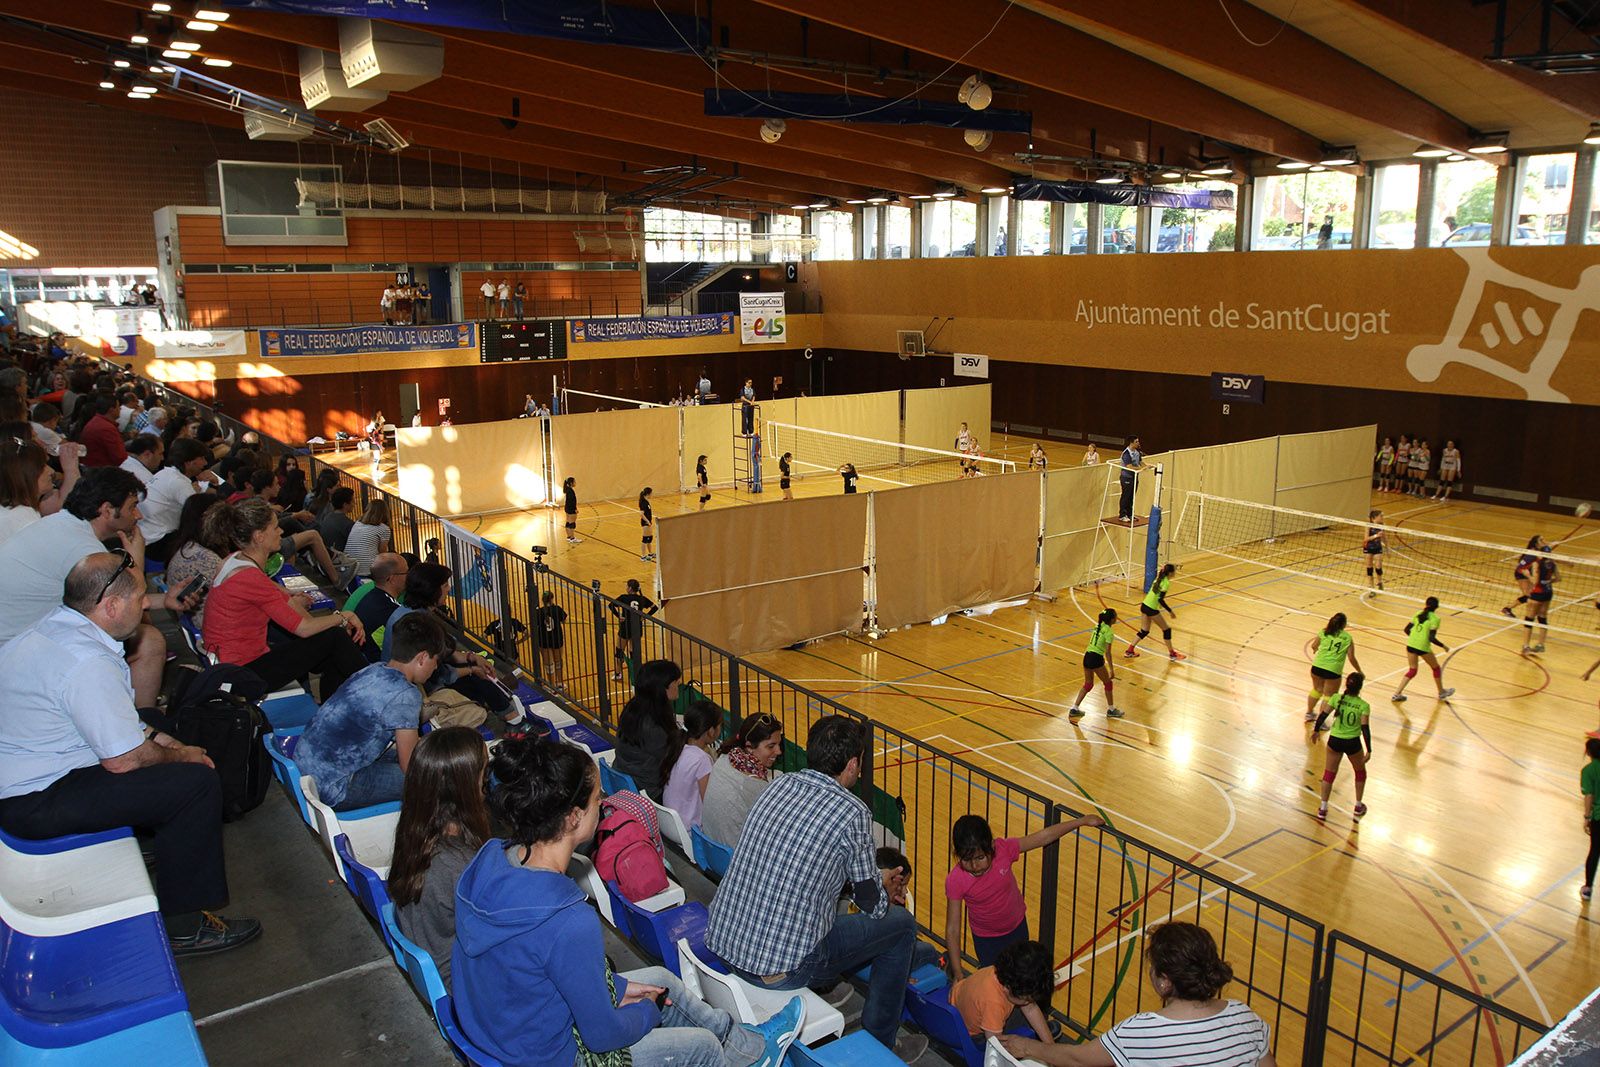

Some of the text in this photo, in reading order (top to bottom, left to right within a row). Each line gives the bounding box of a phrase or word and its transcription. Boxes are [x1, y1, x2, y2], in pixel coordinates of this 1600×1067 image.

[788, 265, 796, 279] C
[588, 323, 605, 336] REAL
[648, 318, 680, 333] ESPAÑOLA
[681, 319, 689, 332] DE
[690, 317, 719, 332] VOLEIBOL
[1075, 299, 1391, 341] Ajuntament de SantCugat
[284, 334, 307, 349] REAL
[362, 328, 404, 346] ESPAÑOLA
[405, 331, 416, 345] DE
[417, 328, 455, 344] VOLEIBOL
[804, 348, 813, 359] C
[961, 357, 980, 367] DSV
[1222, 377, 1252, 390] DSV
[1327, 639, 1342, 654] 14
[1340, 709, 1356, 727] 10
